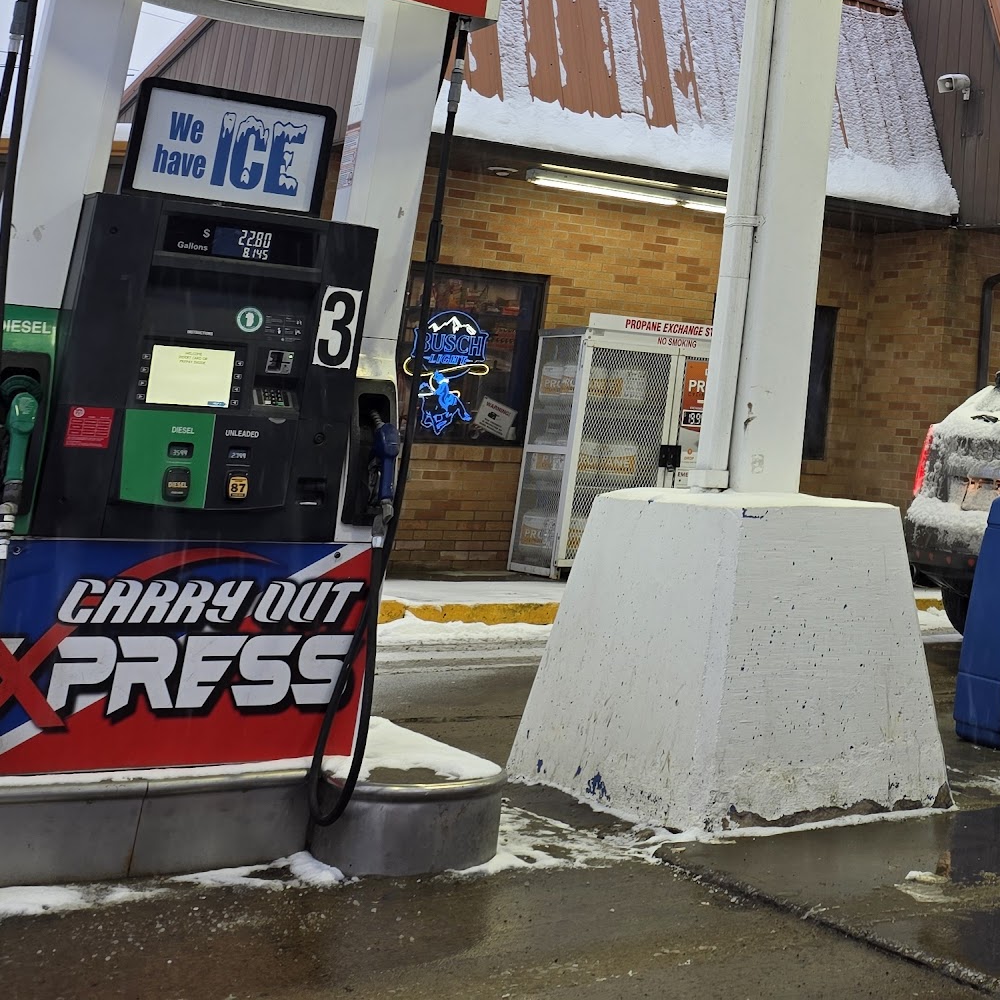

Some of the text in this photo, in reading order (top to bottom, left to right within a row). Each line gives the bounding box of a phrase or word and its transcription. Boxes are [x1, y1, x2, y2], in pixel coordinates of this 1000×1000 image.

[152, 143, 207, 179] have
[169, 111, 205, 144] We
[210, 112, 307, 196] ICE
[177, 240, 208, 251] Gallons
[317, 290, 356, 366] 3
[625, 319, 661, 333] PROPANE
[663, 323, 703, 336] EXCHANGE
[424, 332, 483, 356] BUSCH
[657, 337, 697, 348] NO SMOKING
[428, 353, 468, 366] LIGHT
[171, 426, 260, 438] DIESEL UNLEADED
[231, 483, 246, 493] 87
[58, 578, 364, 624] CARRY OUT
[0, 625, 356, 728] XPRESS
